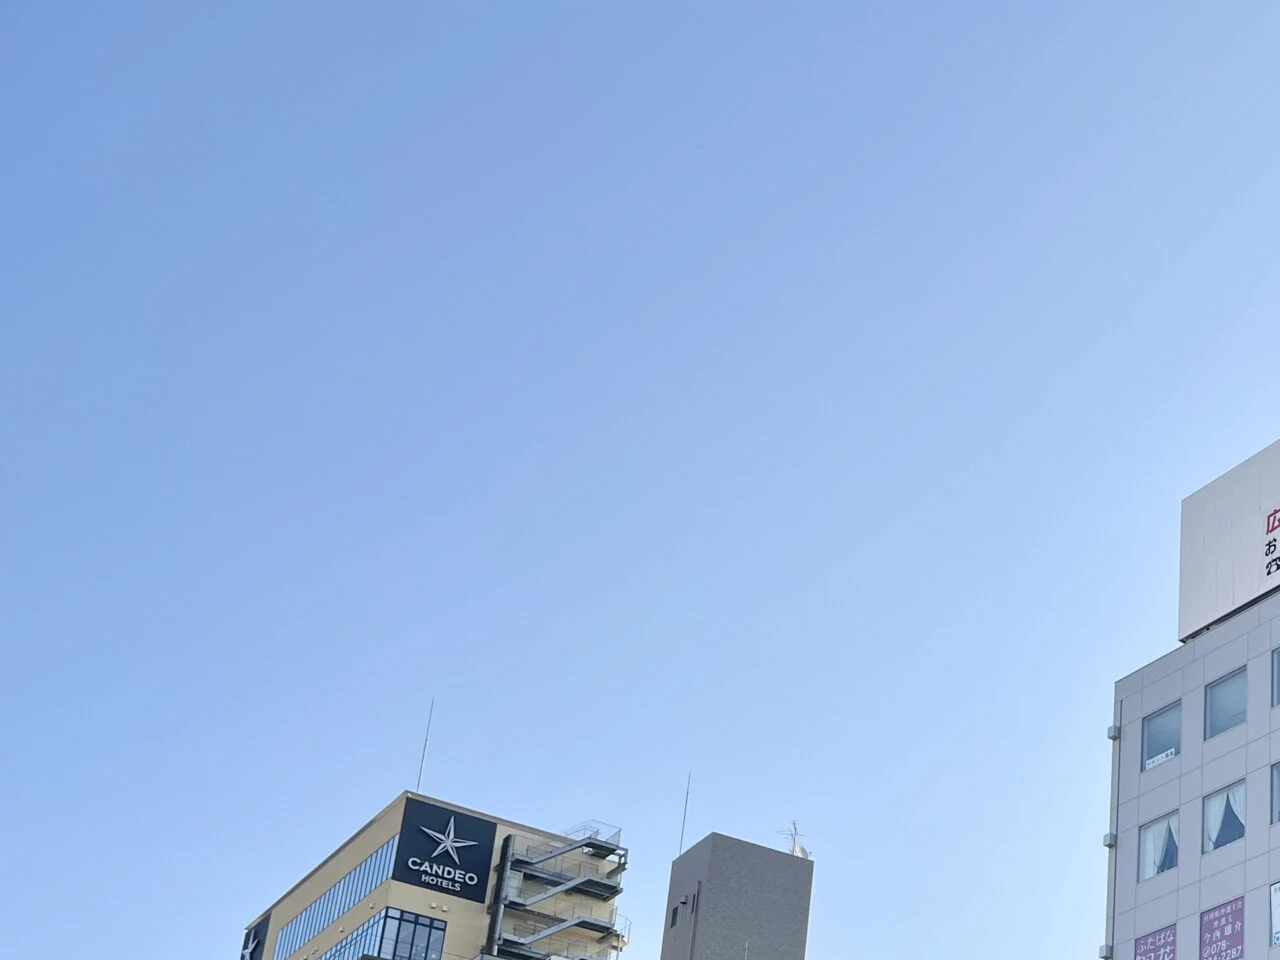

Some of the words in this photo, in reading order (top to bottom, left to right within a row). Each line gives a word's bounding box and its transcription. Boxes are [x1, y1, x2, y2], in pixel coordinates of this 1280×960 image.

[407, 857, 479, 886] CANDEO
[420, 873, 461, 892] HOTELS
[1136, 929, 1176, 954] ふたばな
